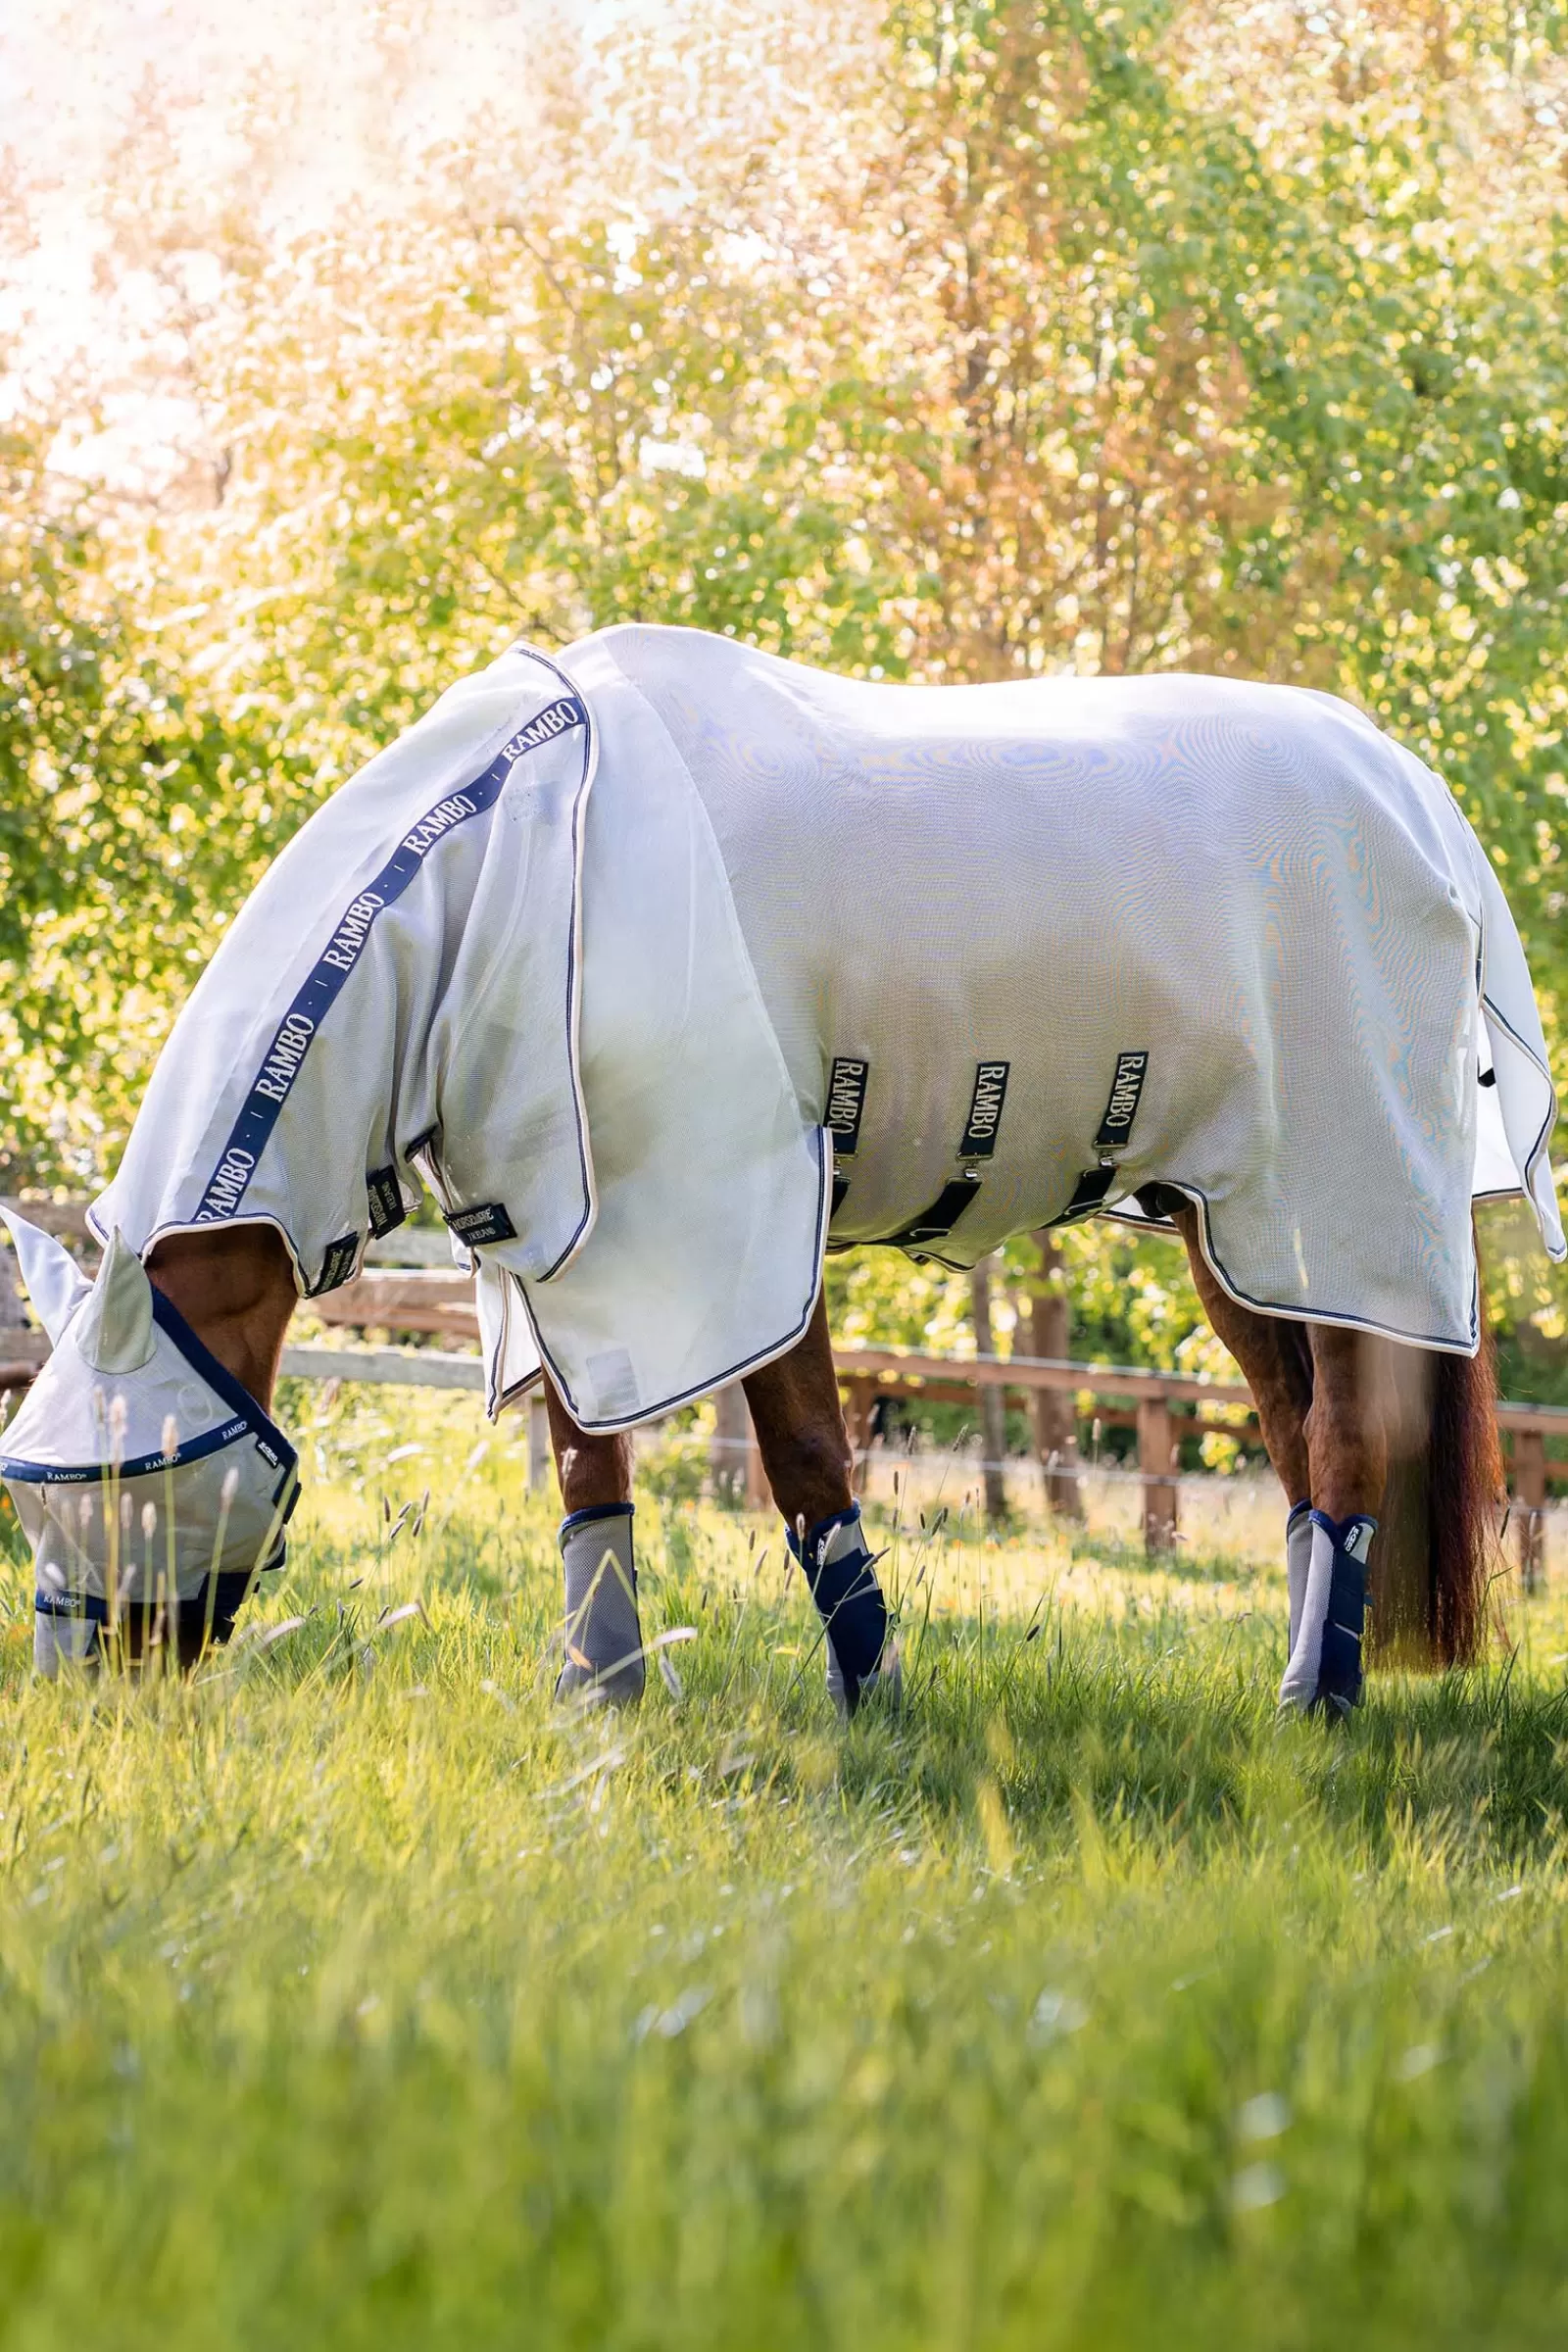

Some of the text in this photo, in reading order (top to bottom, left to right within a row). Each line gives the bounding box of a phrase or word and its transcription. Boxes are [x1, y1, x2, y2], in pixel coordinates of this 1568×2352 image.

[501, 701, 578, 763] RAMBO
[401, 795, 477, 857] RAMBO
[322, 892, 384, 971] RAMBO
[255, 1013, 315, 1102] RAMBO
[1105, 1055, 1145, 1127] RAMBO
[827, 1060, 864, 1134] RAMBO
[968, 1065, 1005, 1138] RAMBO
